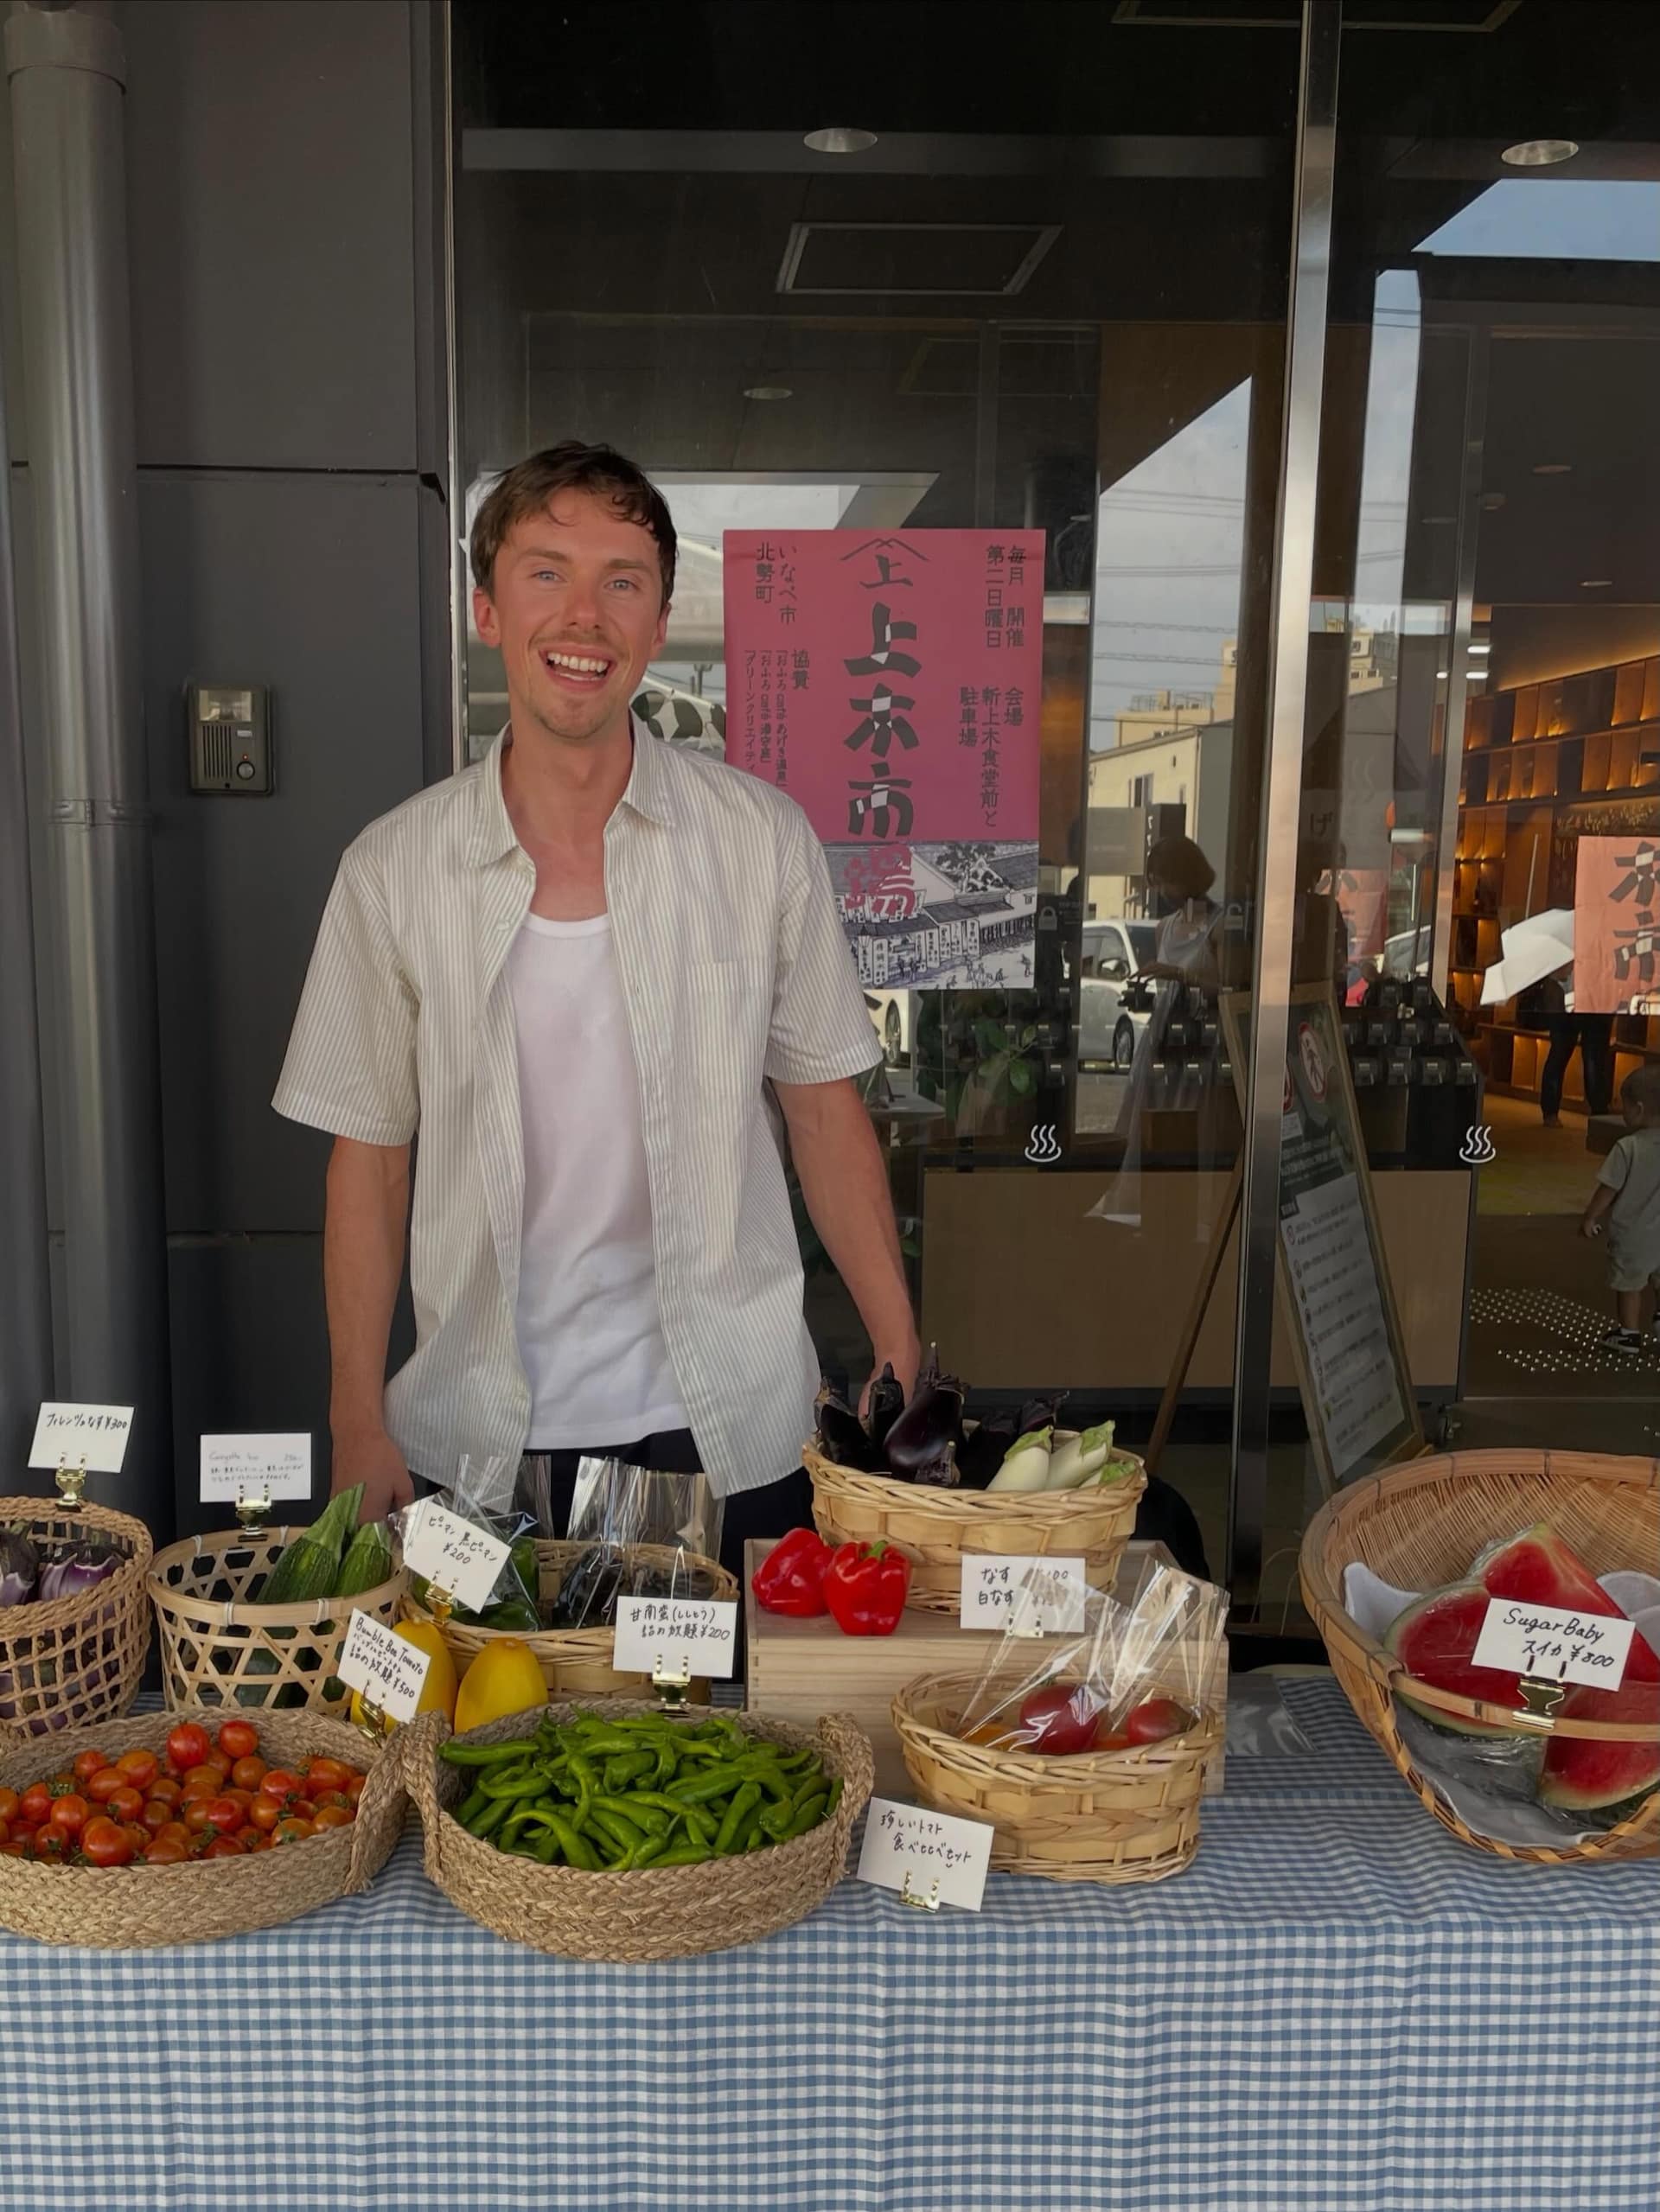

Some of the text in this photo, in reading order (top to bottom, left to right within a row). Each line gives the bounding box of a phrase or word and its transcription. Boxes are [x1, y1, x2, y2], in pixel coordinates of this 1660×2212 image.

[756, 542, 775, 603] 北勢町
[986, 545, 1005, 648] 第二日曜日
[959, 686, 978, 747] 駐車場
[1004, 686, 1024, 726] 会場
[979, 1590, 1014, 1607] 白なす
[980, 1566, 1011, 1585] なす
